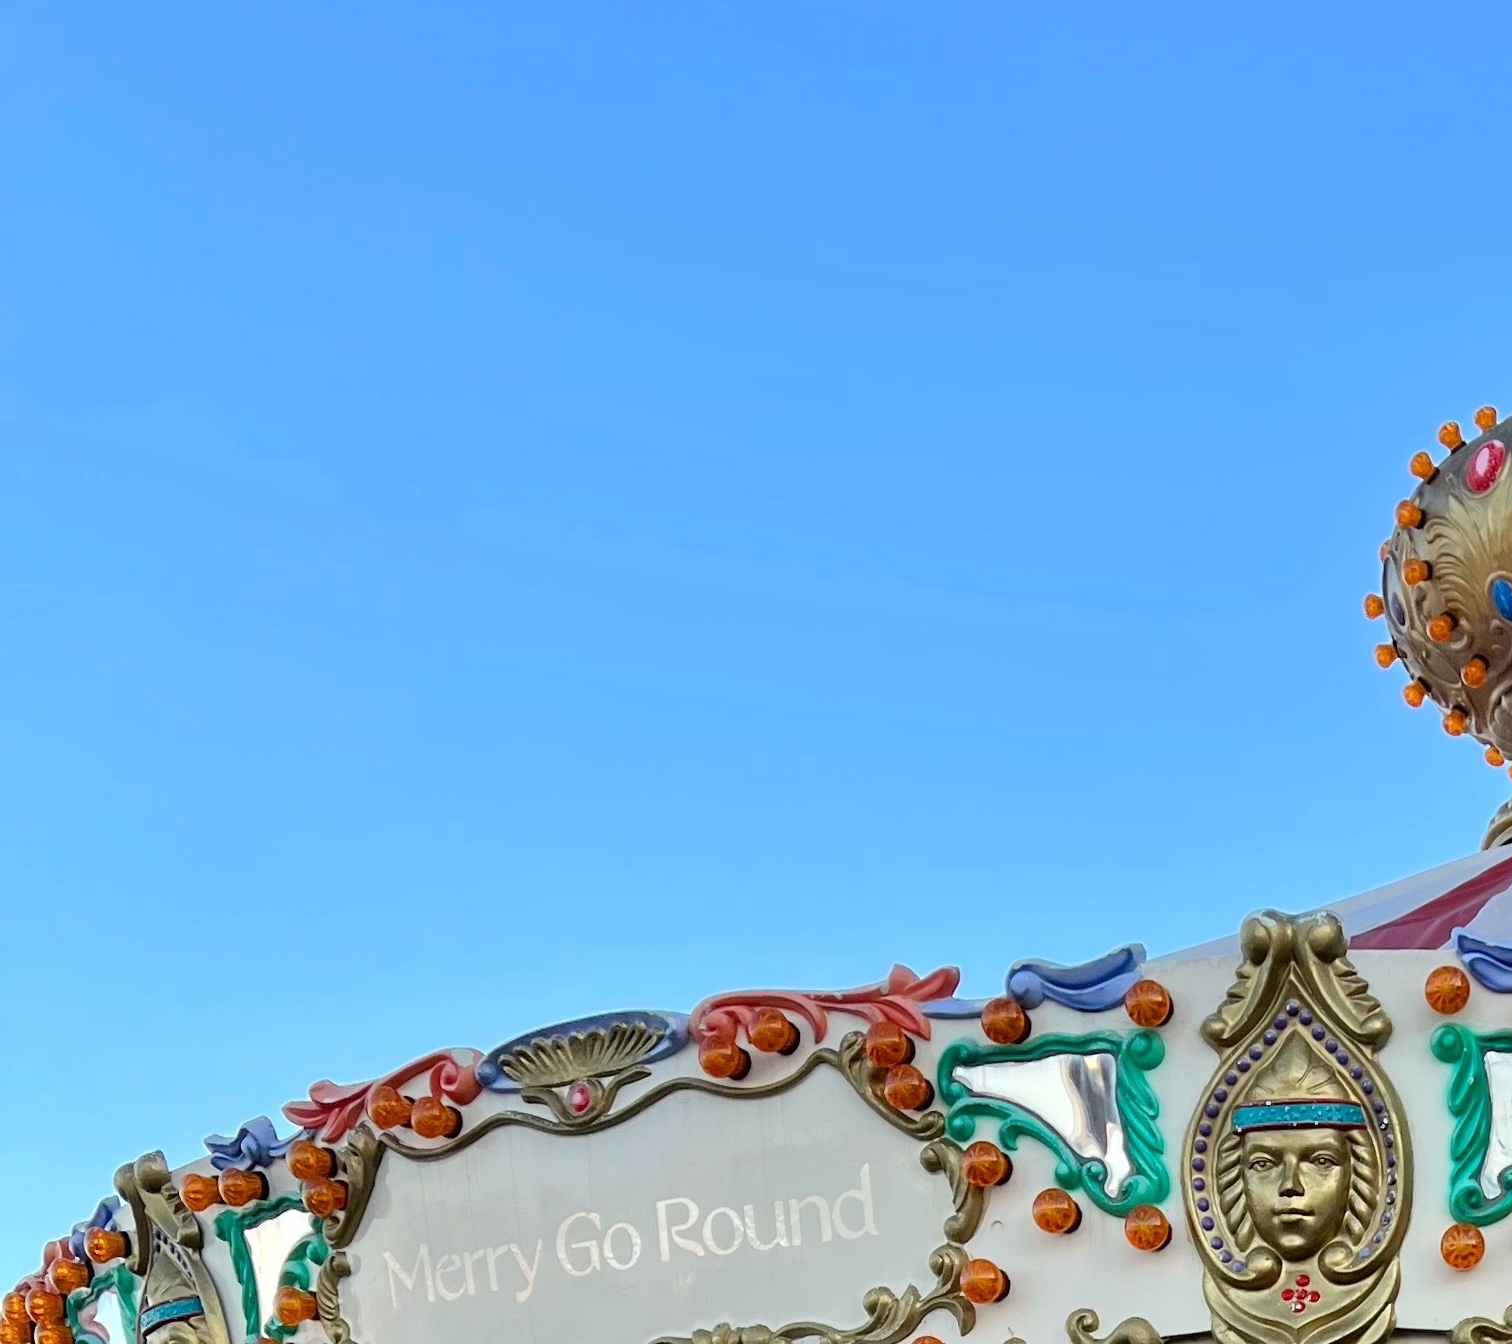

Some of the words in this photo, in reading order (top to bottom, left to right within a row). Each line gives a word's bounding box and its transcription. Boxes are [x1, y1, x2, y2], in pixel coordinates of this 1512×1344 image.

[384, 1238, 542, 1308] Merry
[556, 1211, 641, 1277] Go
[656, 1163, 879, 1262] Round
